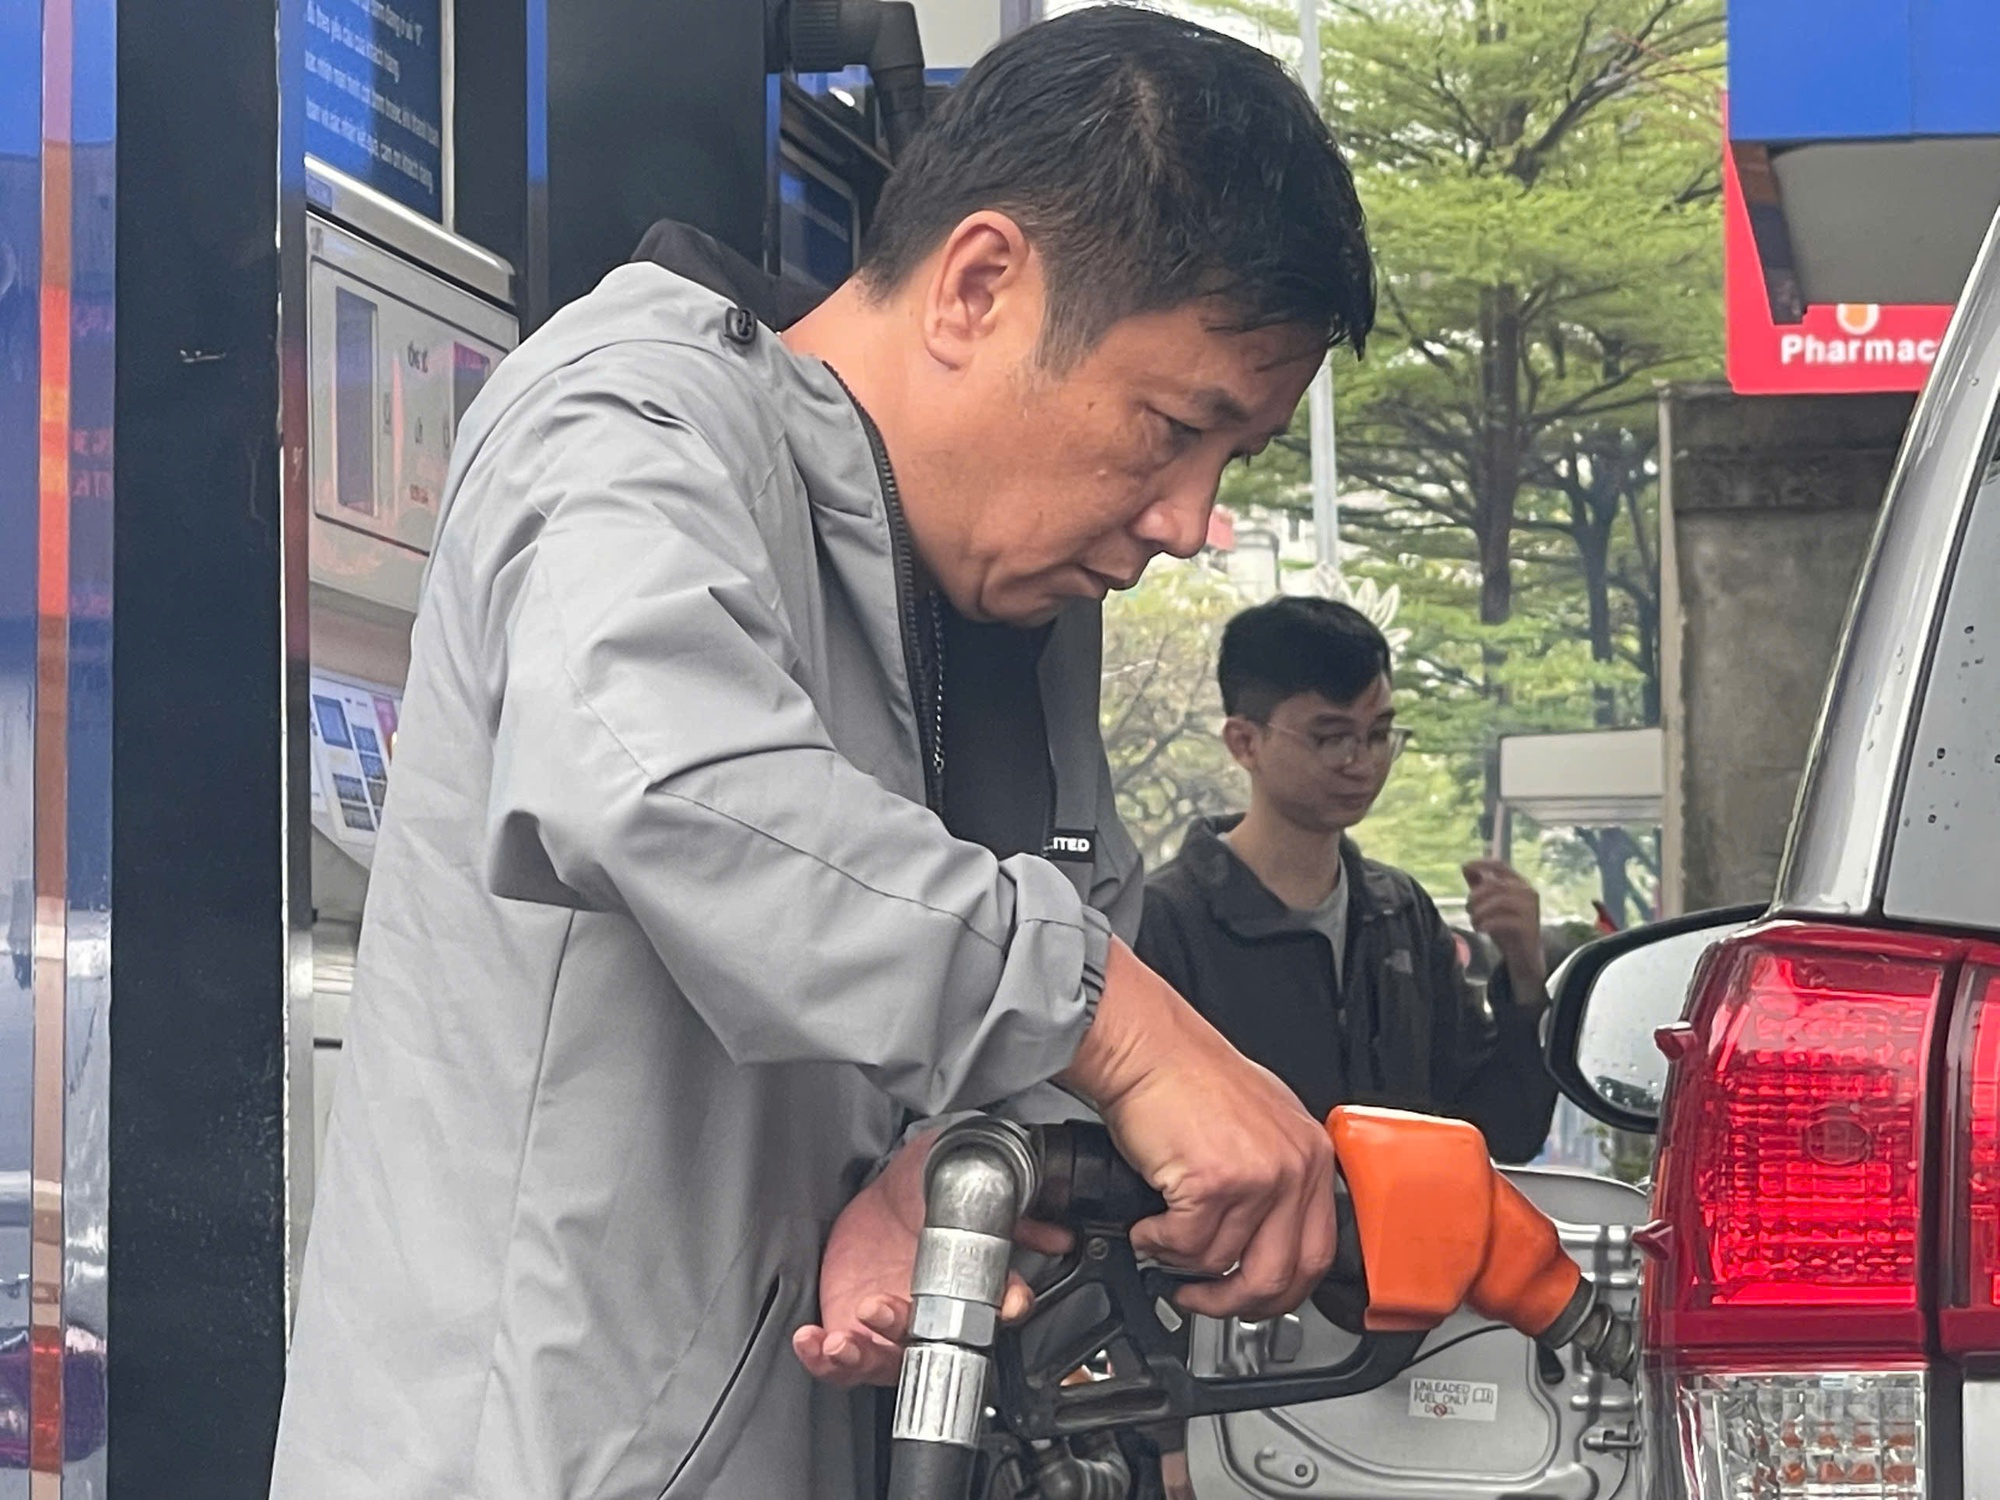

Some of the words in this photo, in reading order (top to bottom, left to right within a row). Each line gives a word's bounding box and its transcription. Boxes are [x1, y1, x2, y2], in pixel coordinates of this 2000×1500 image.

[1781, 334, 1940, 364] Pharmac
[1052, 836, 1090, 852] ITED
[1414, 1381, 1470, 1394] UNLEADED
[1414, 1391, 1437, 1403] FUEL
[1443, 1394, 1469, 1406] ONLY
